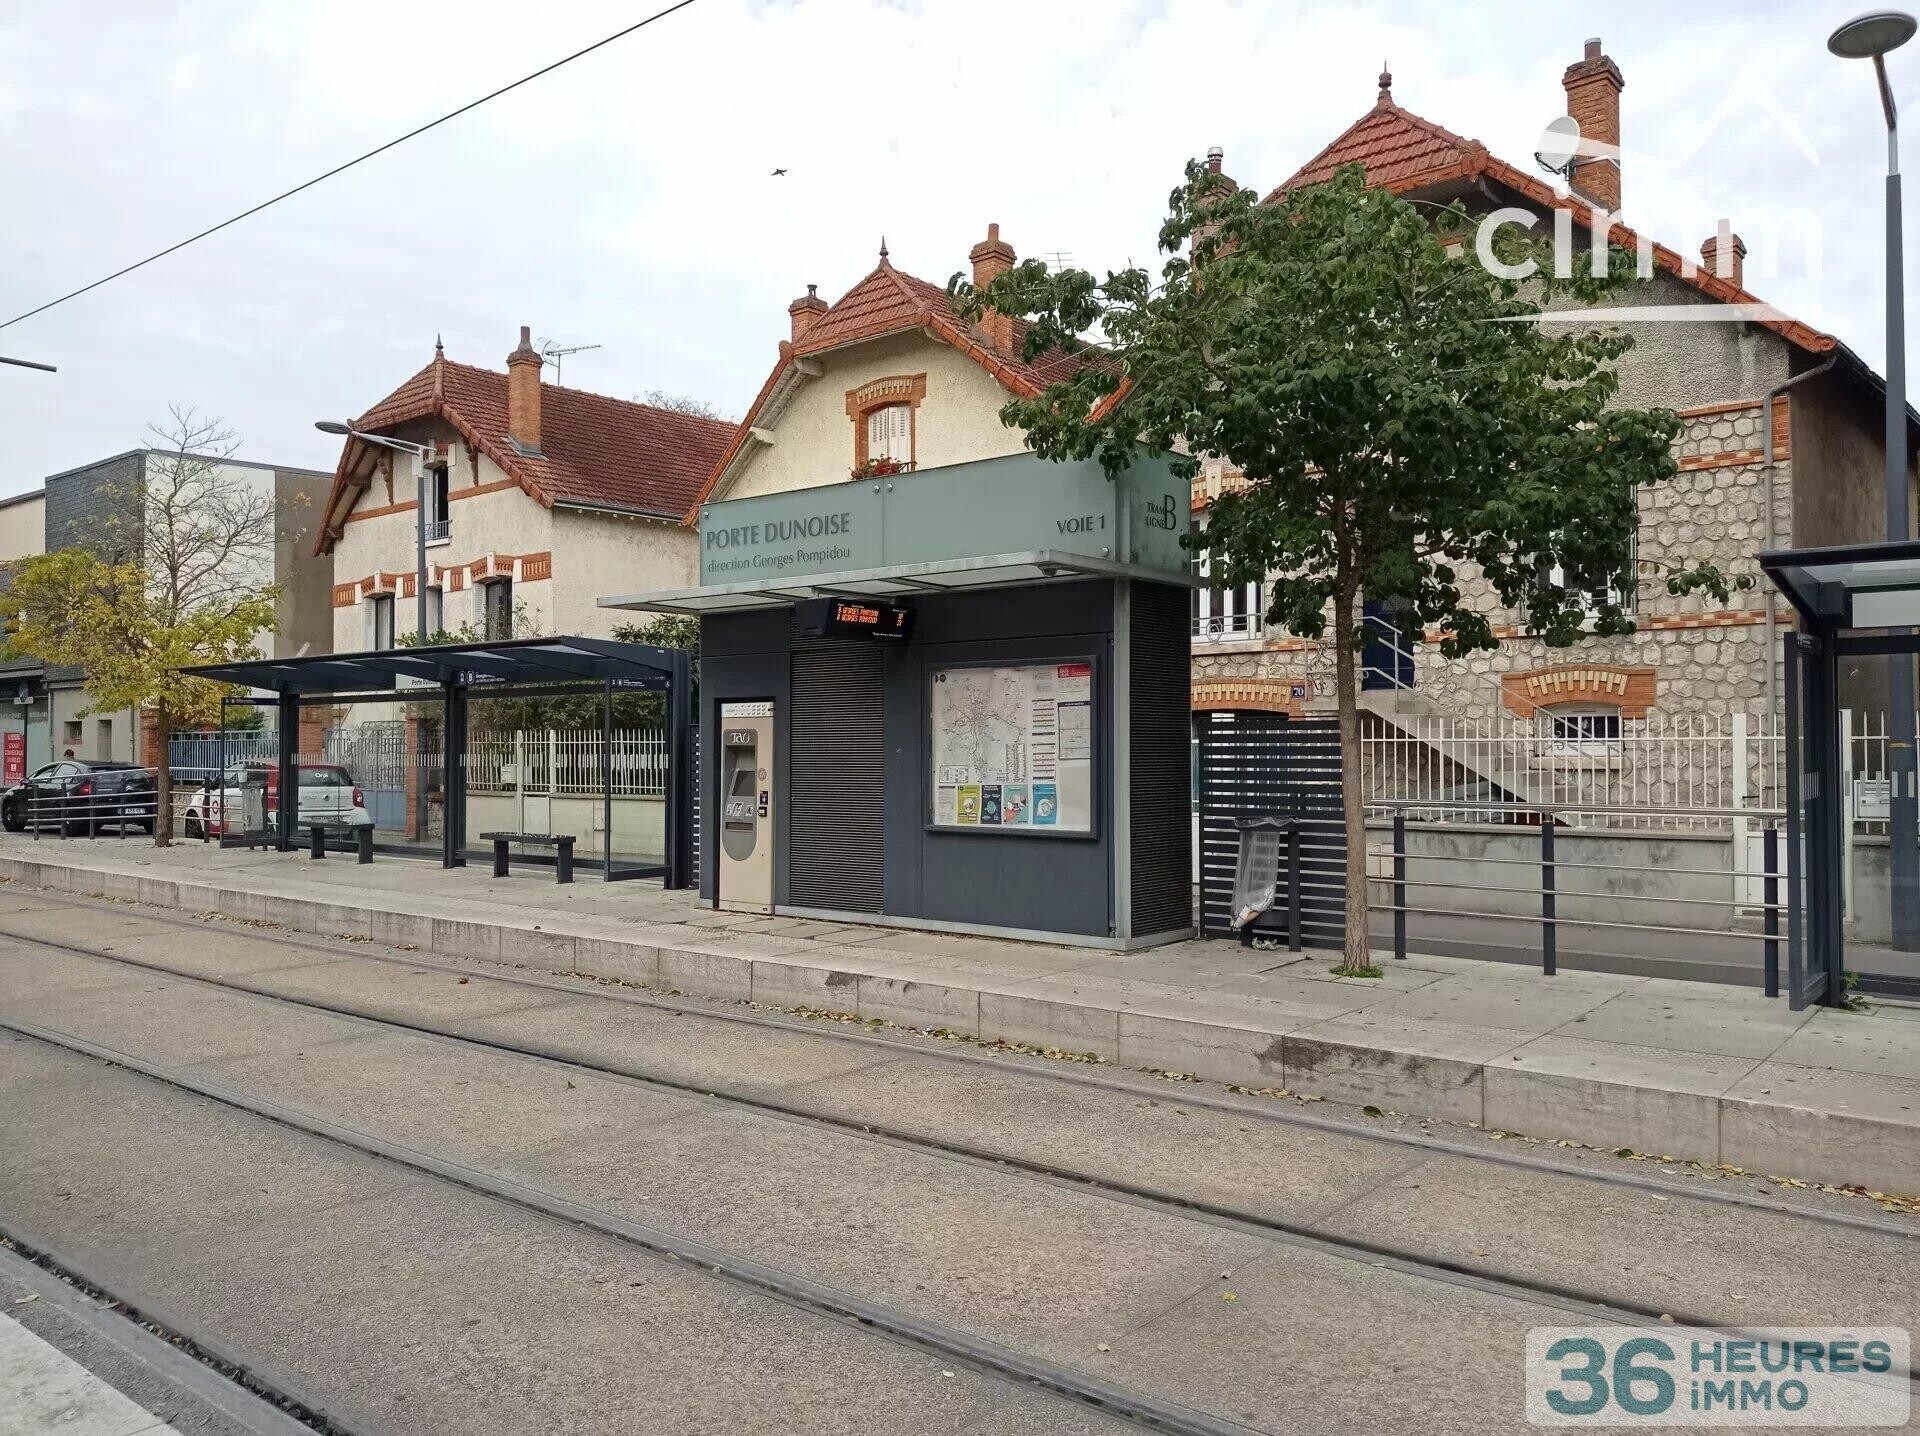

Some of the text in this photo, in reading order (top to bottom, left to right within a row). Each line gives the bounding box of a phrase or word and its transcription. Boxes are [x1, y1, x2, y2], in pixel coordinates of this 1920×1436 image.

[1147, 502, 1165, 515] TRAM
[1164, 494, 1176, 530] B
[706, 512, 850, 550] PORTE DUNOISE
[1056, 514, 1105, 535] VOIE 1
[1146, 516, 1165, 529] LIGNE
[708, 545, 850, 573] direction Georges Pompidou
[1293, 687, 1304, 696] 70
